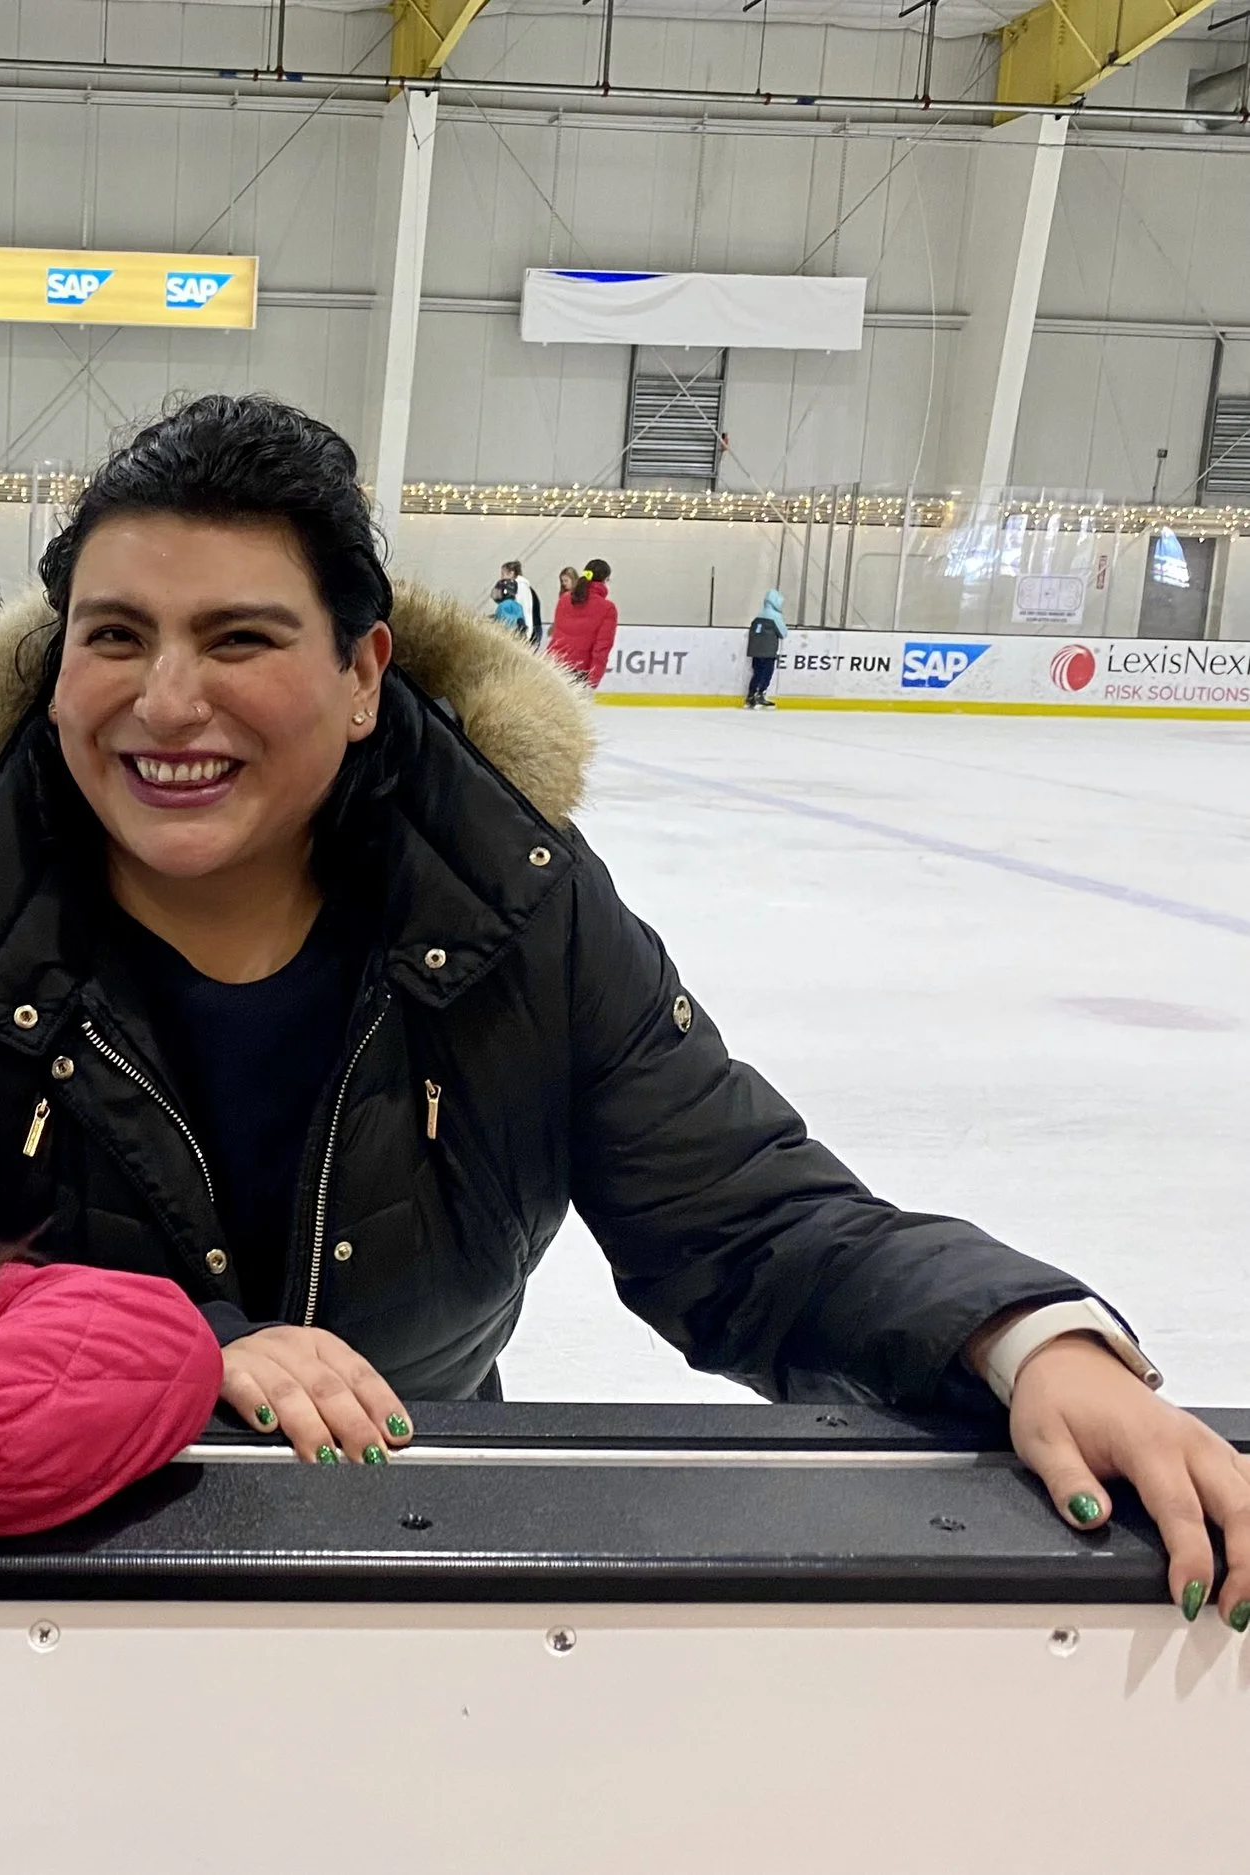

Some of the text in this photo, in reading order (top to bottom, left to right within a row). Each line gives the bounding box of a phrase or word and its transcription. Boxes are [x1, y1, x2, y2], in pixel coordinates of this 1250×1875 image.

[47, 273, 101, 299] SAP
[166, 277, 220, 303] SAP
[606, 650, 689, 675] IGHT
[794, 655, 845, 671] BEST
[850, 656, 891, 672] RUN
[902, 650, 969, 681] SAP
[1104, 685, 1250, 702] RISK SOLUTIONS
